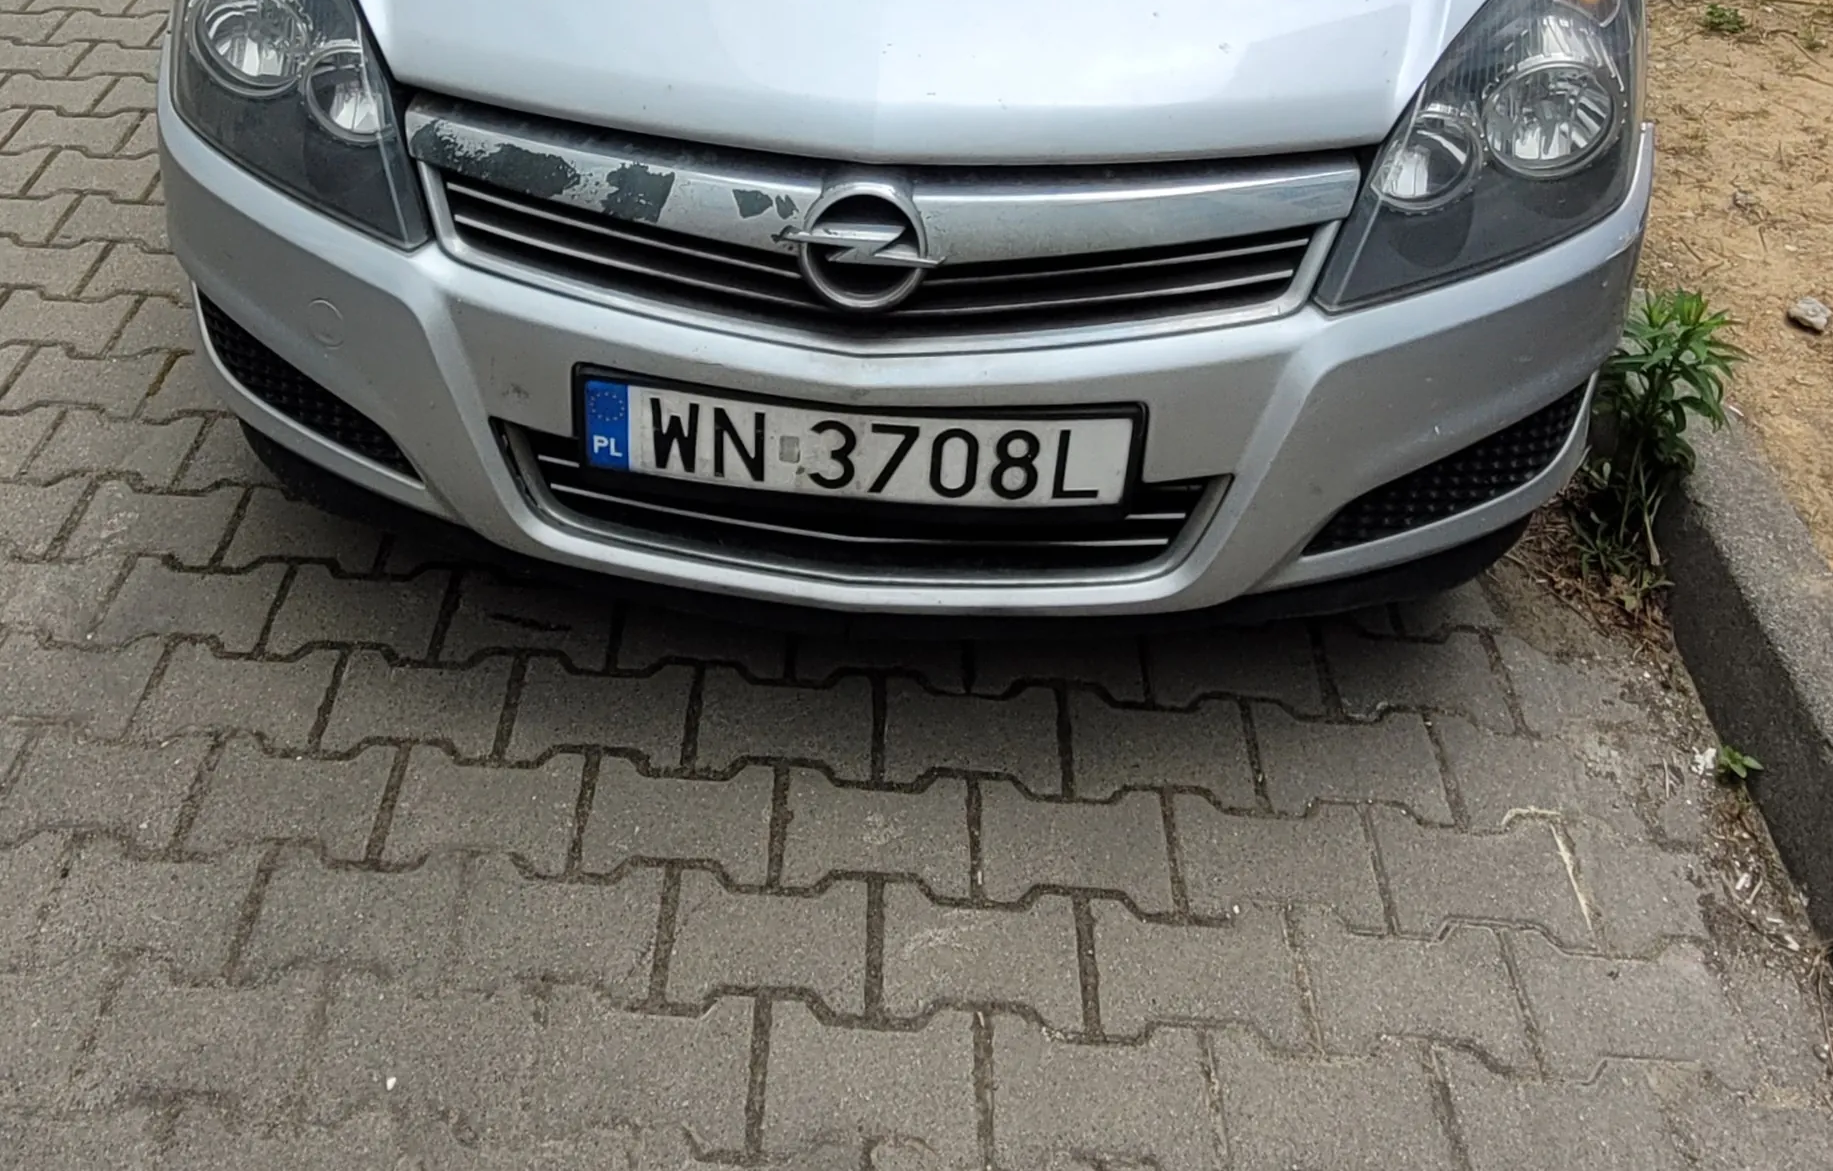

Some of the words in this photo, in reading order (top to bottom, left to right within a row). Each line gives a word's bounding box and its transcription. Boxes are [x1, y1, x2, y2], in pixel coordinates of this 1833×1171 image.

[593, 434, 623, 458] PL
[650, 397, 766, 483] WN
[807, 420, 1099, 500] 3708L
